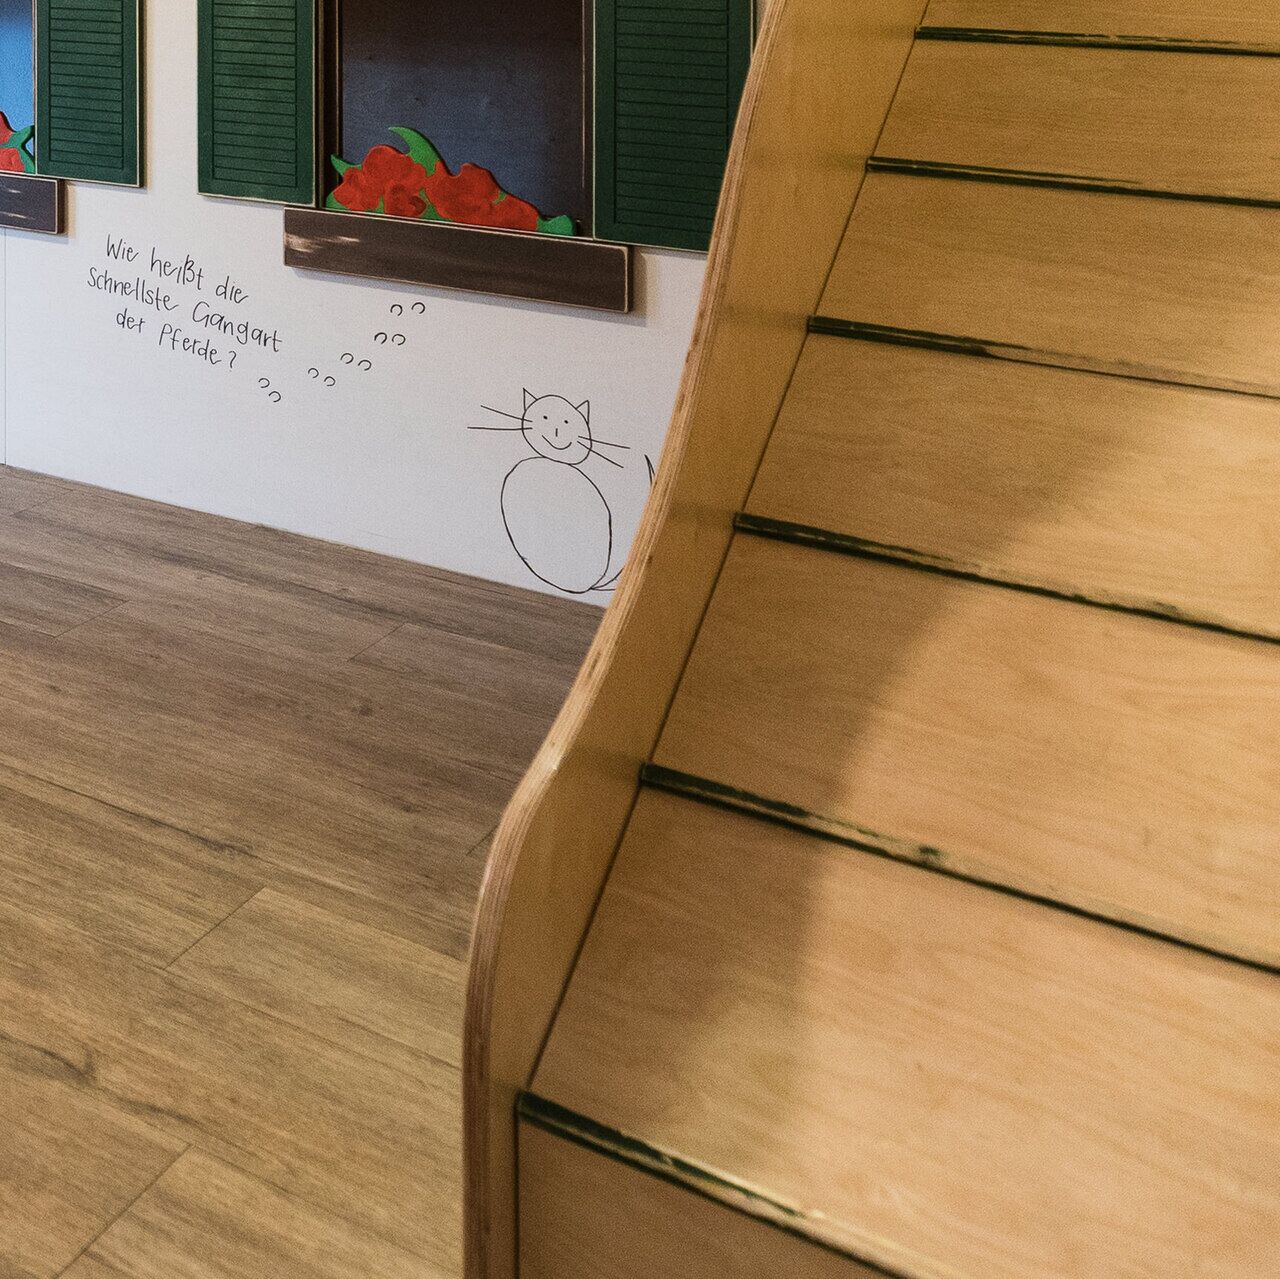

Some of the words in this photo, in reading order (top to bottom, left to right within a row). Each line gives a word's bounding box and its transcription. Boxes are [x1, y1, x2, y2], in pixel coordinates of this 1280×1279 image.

[105, 233, 140, 263] Wie
[150, 246, 204, 291] heißt
[214, 275, 250, 305] die
[115, 307, 146, 334] der
[191, 300, 283, 353] Gangart
